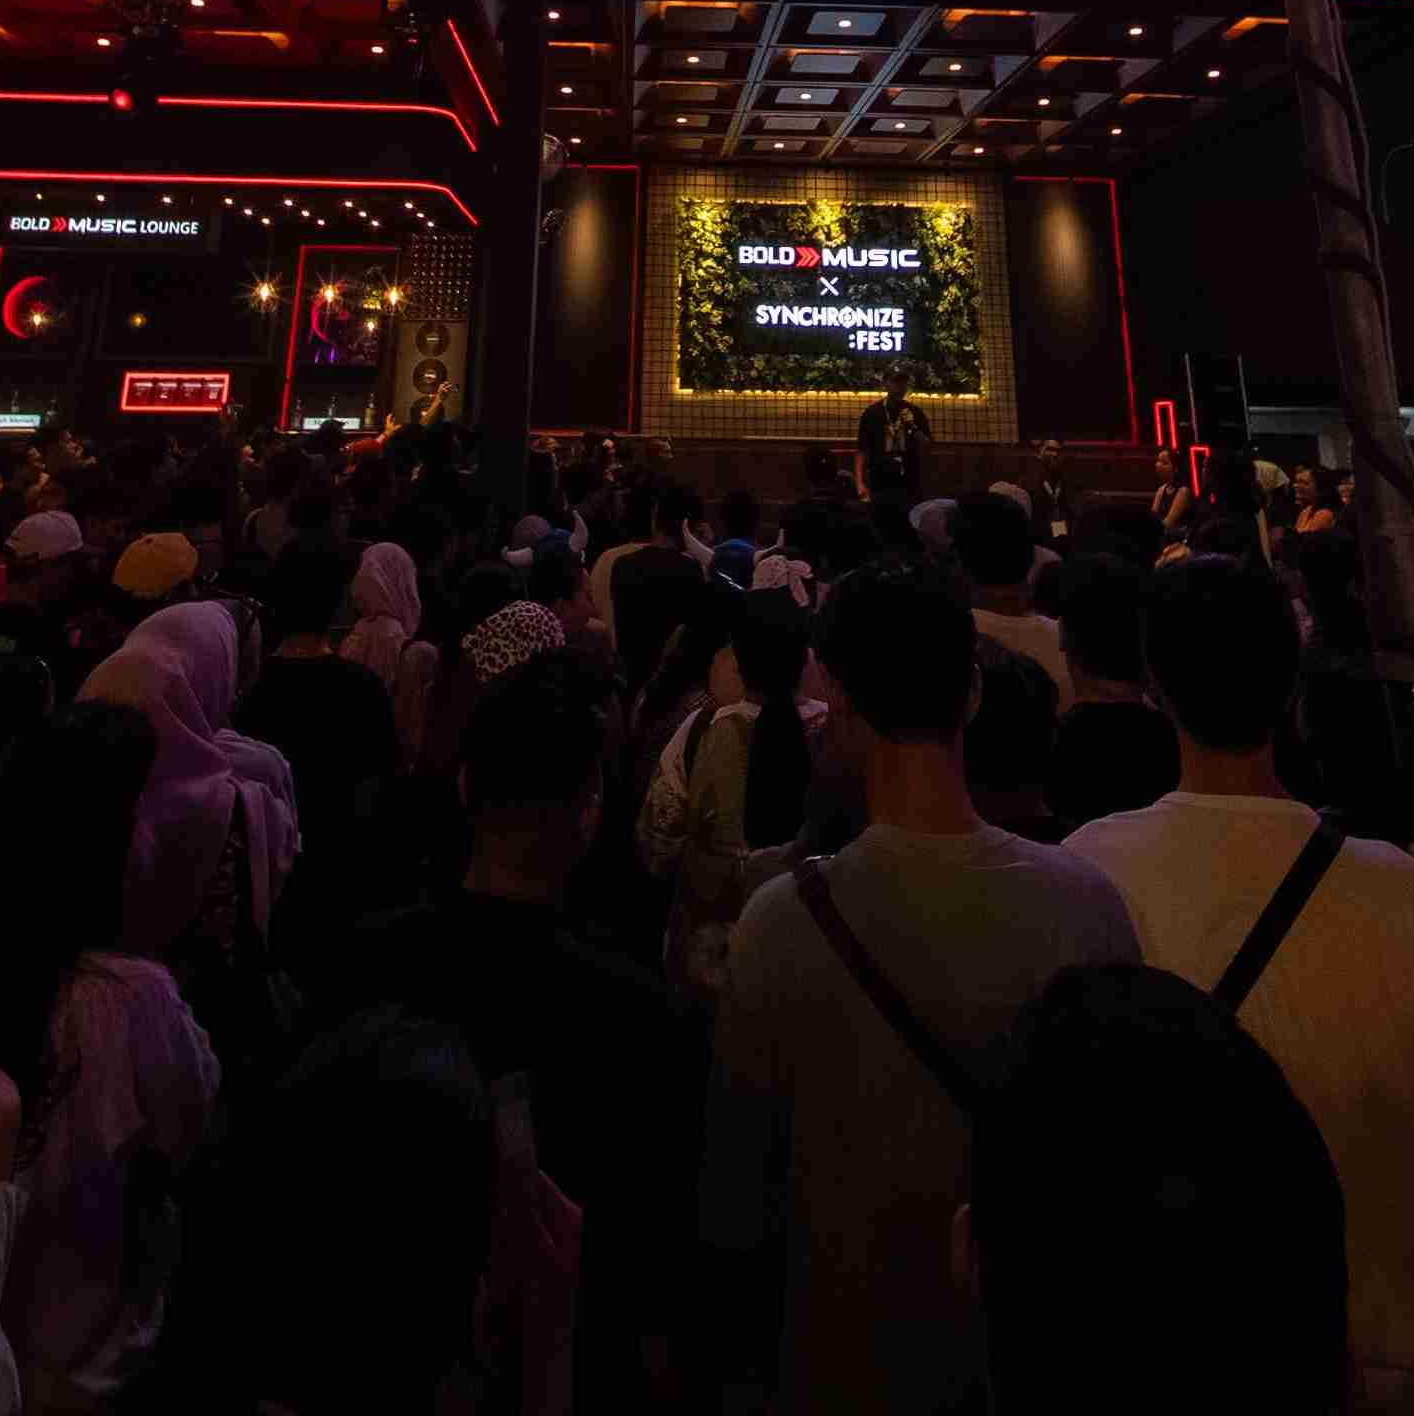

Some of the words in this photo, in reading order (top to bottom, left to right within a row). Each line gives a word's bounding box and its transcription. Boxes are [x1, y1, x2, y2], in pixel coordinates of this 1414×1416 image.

[9, 216, 50, 231] BOLD
[68, 217, 137, 234] MUSIC
[140, 220, 199, 235] LOUNGE
[738, 245, 795, 266] BOLD
[823, 246, 922, 269] MUSIC
[755, 304, 905, 329] SYNCHRONIZE
